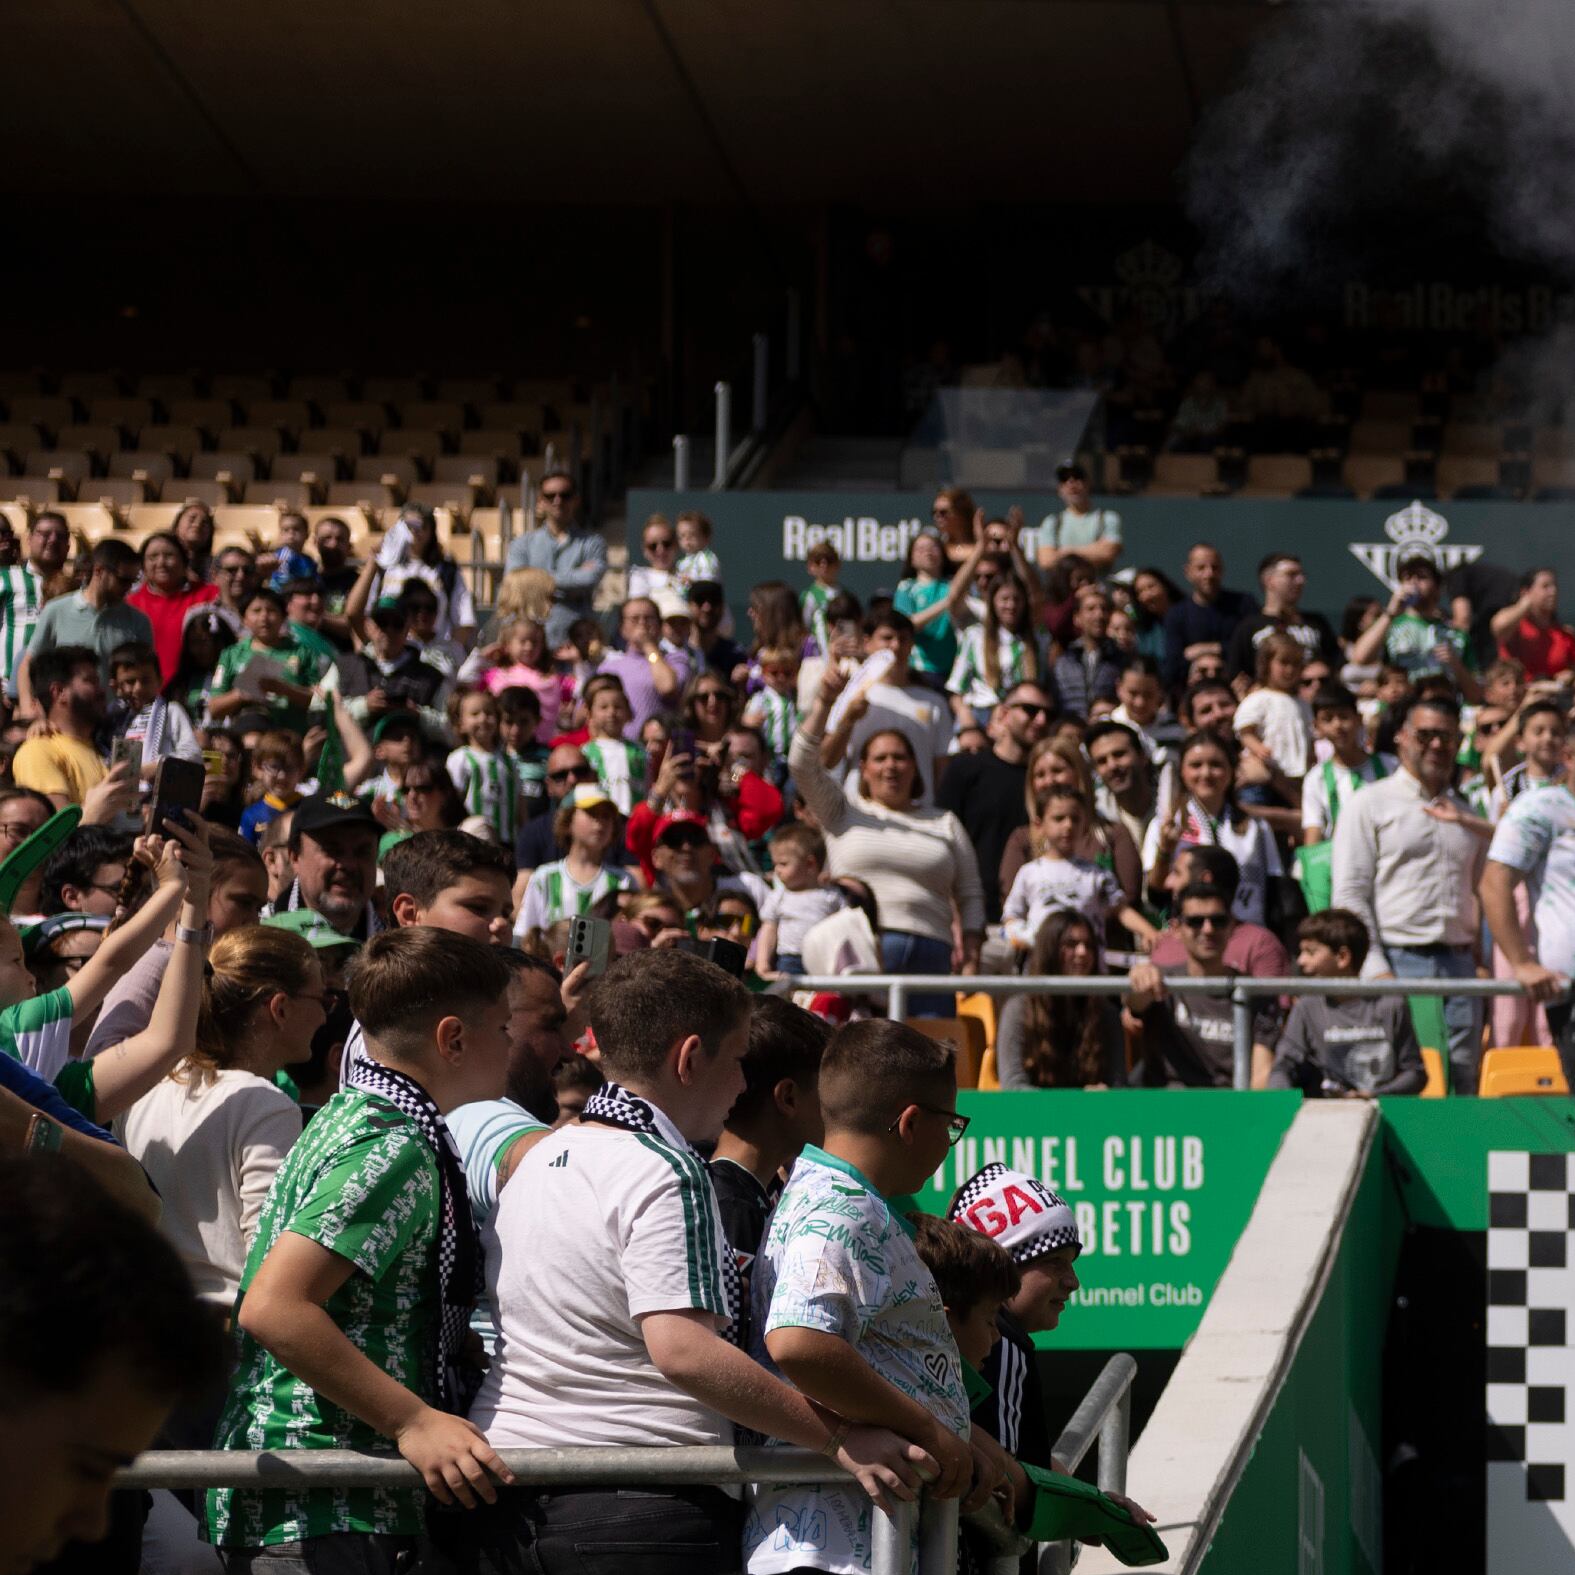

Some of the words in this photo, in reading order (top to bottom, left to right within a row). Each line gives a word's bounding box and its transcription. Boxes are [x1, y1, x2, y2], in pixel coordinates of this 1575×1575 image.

[1103, 1135, 1205, 1191] CLUB
[1075, 1200, 1192, 1256] BETIS
[1149, 1282, 1203, 1306] Club
